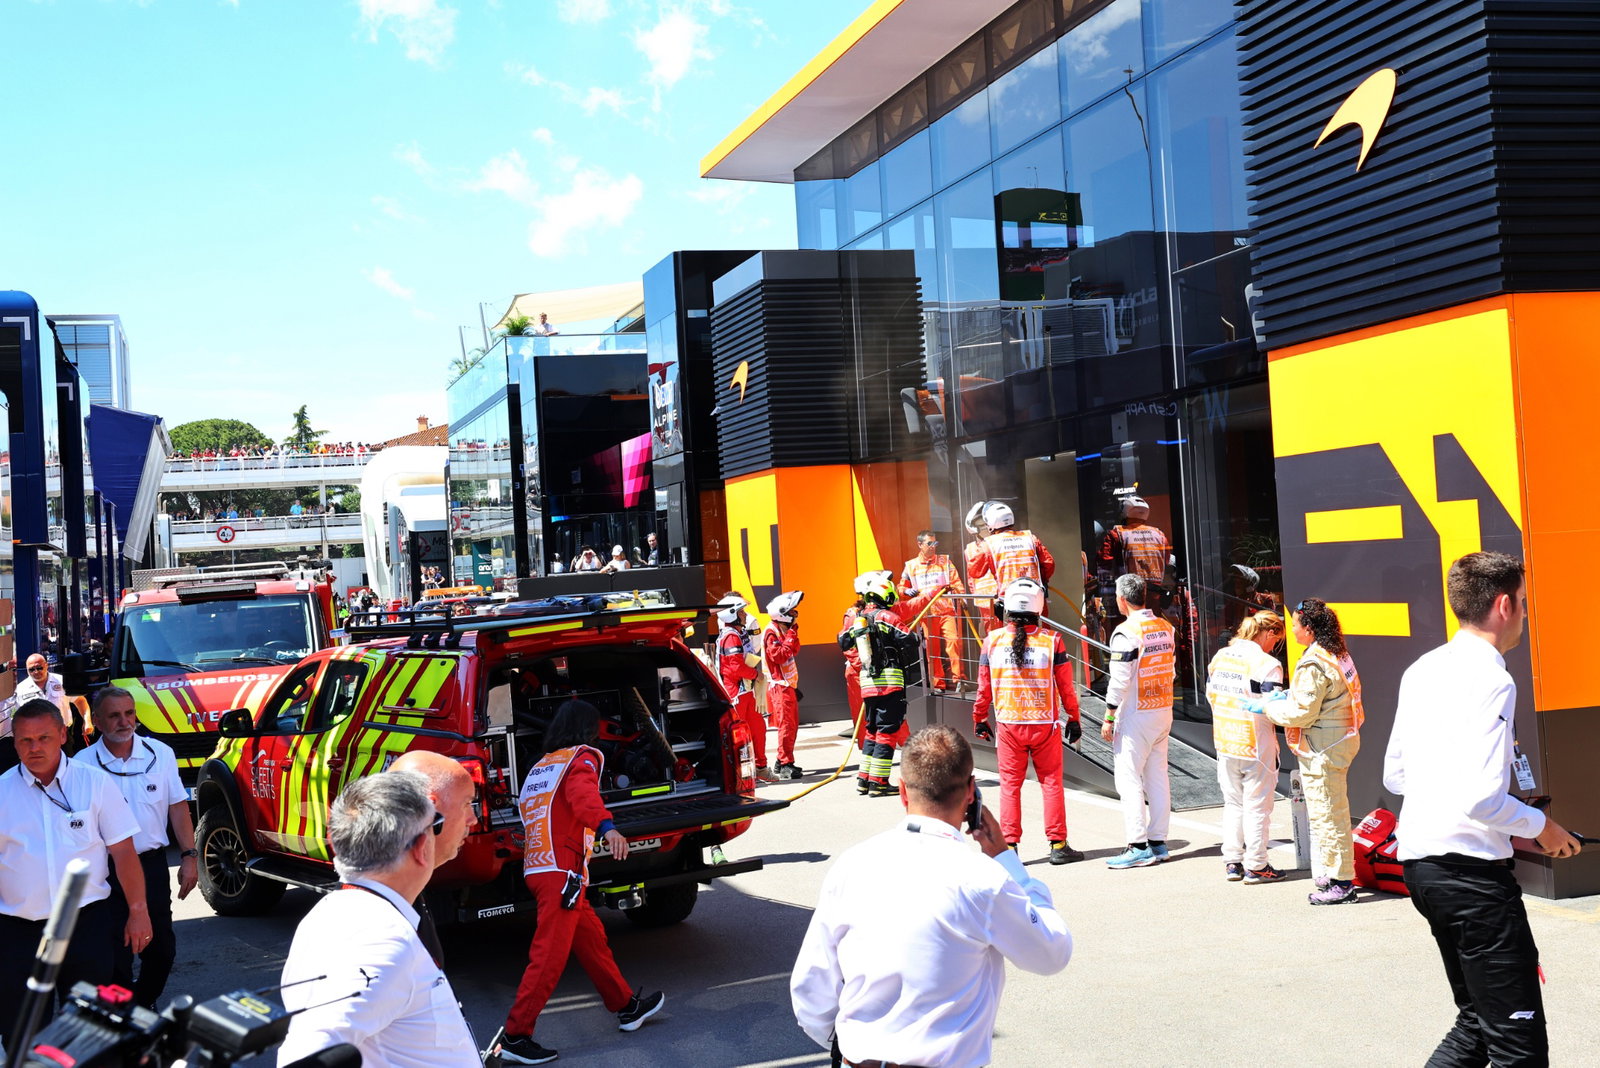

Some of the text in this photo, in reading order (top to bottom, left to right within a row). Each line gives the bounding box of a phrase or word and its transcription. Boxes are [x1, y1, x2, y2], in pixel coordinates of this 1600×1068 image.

[156, 674, 270, 691] BOMBEROS
[997, 690, 1046, 700] PITLANE
[1015, 699, 1046, 708] TIMES
[251, 766, 275, 783] SAFETY
[252, 784, 276, 800] EVENTS
